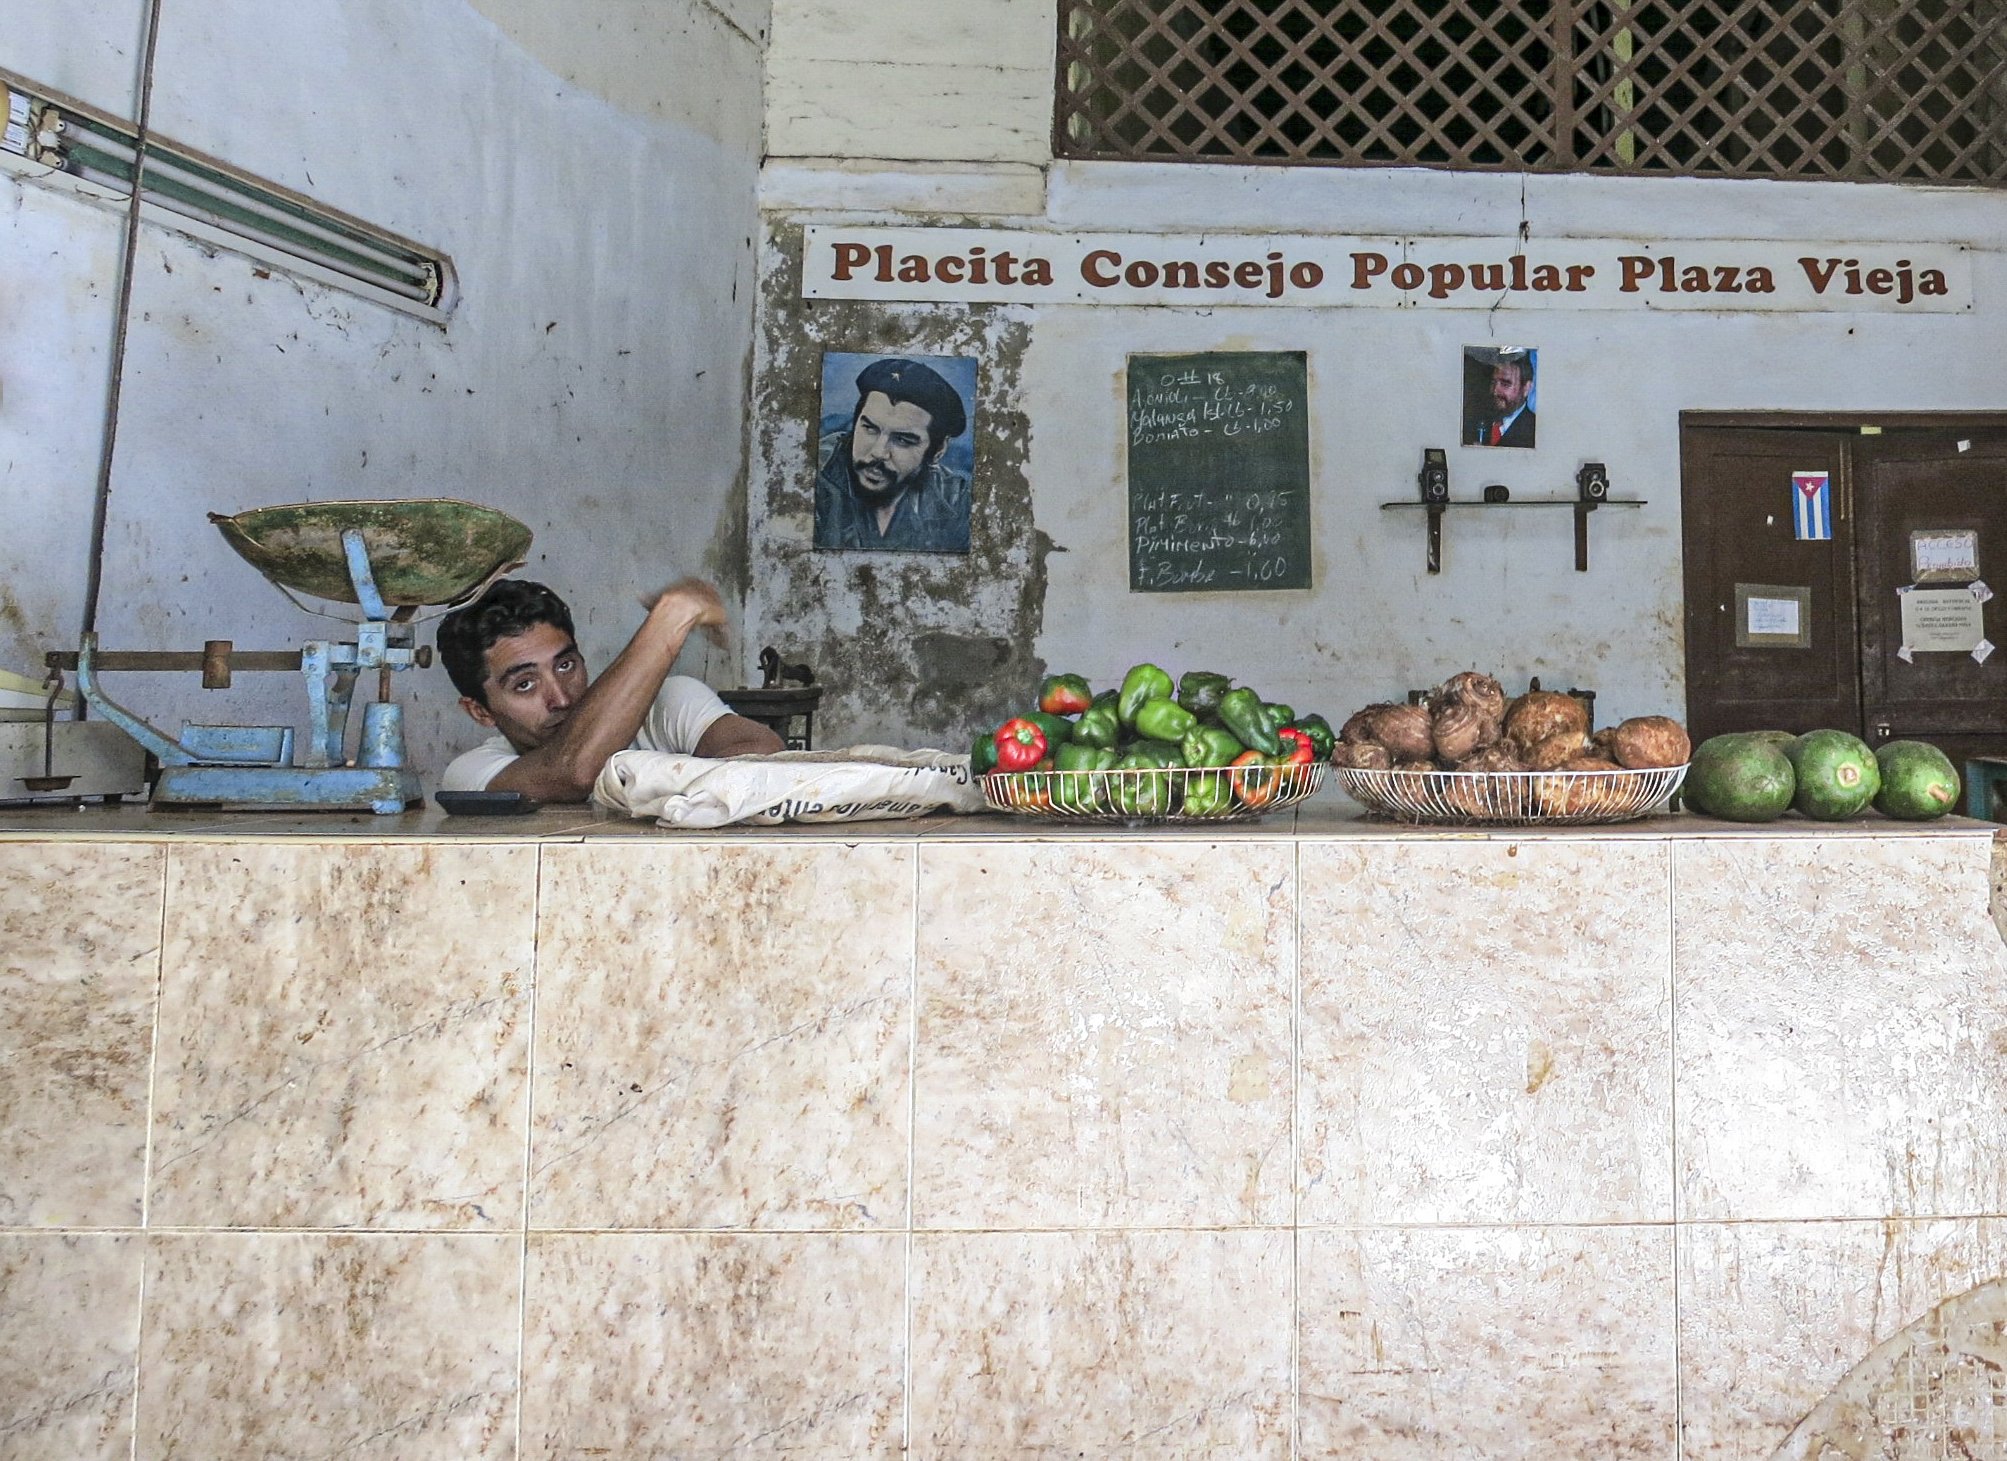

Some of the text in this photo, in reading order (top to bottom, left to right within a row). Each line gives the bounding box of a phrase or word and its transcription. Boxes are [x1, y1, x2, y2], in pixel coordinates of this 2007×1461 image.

[831, 243, 1949, 305] Placita Consejo Popular Plaza Vieja
